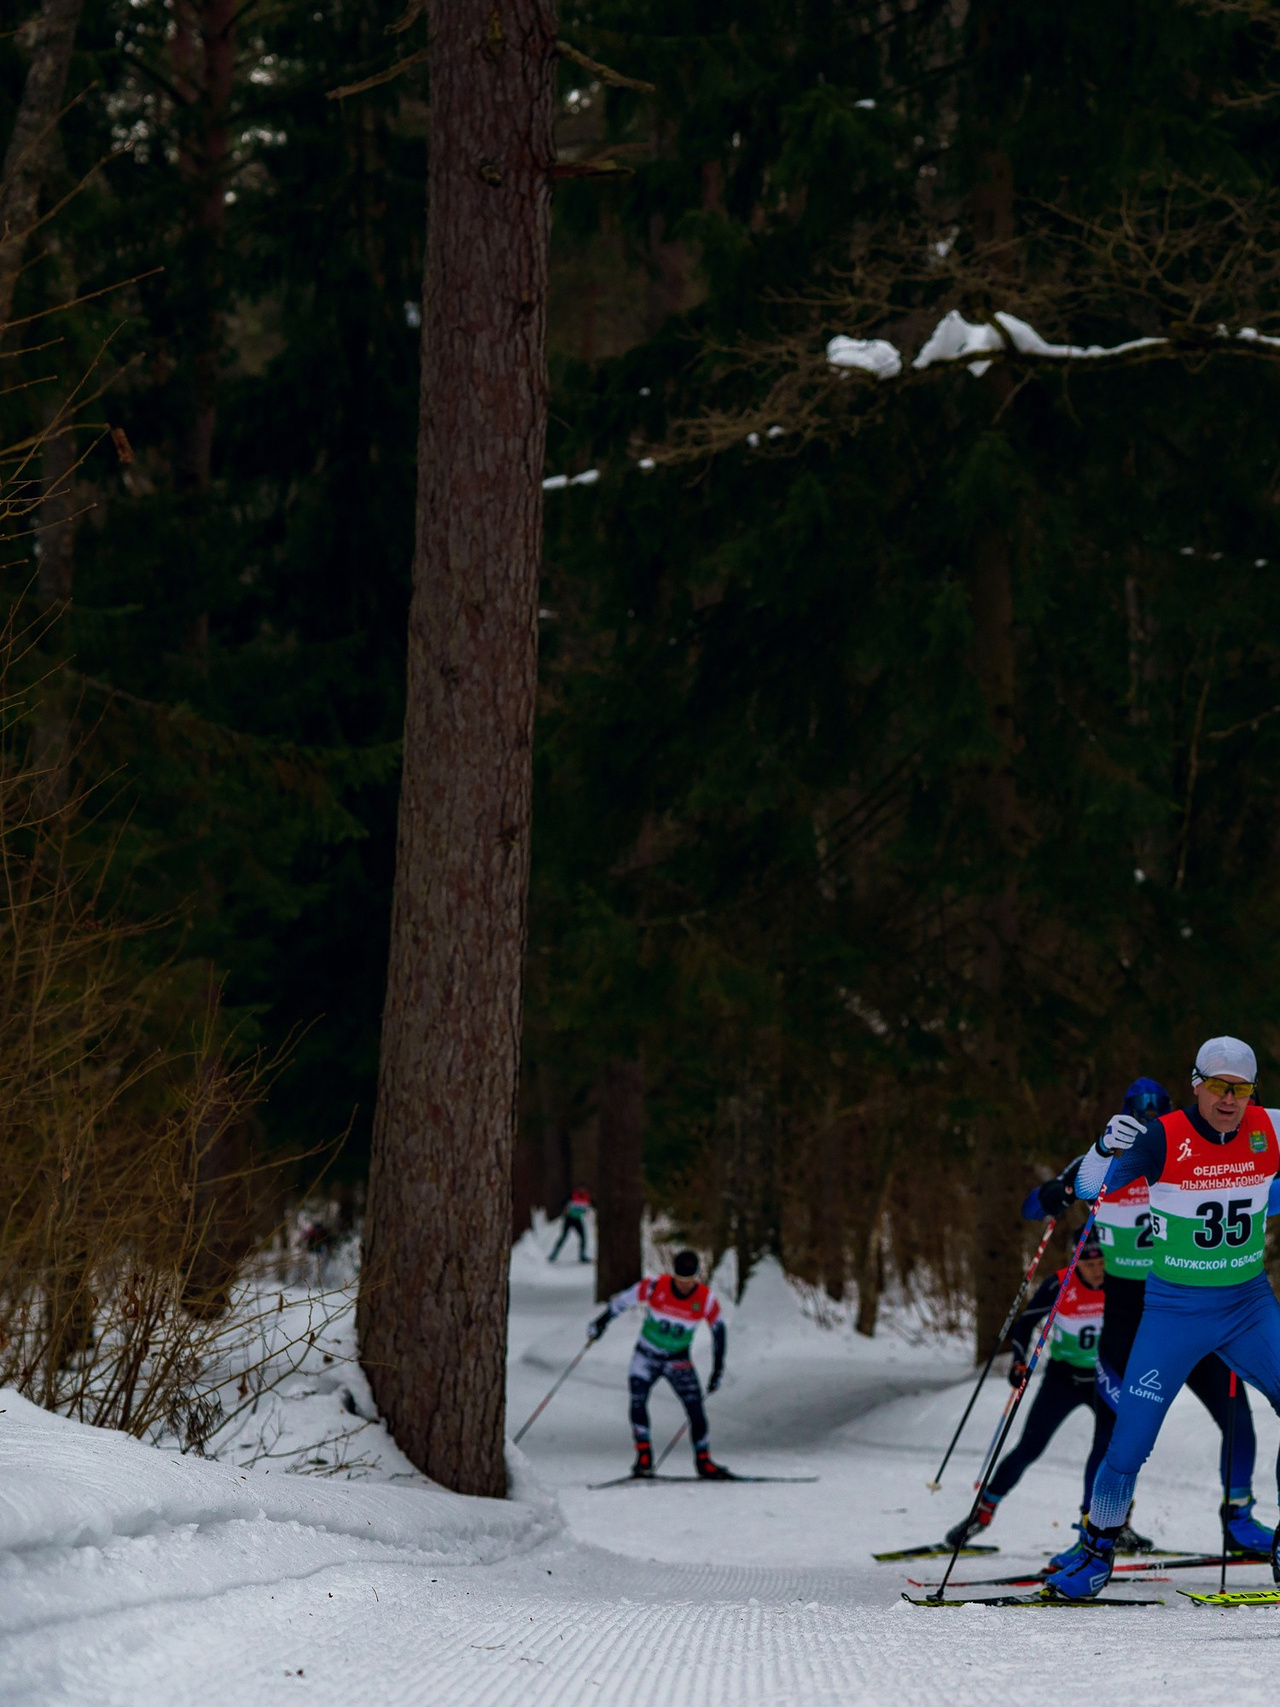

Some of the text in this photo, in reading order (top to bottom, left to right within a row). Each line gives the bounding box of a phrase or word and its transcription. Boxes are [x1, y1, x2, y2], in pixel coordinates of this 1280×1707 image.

[1193, 1161, 1256, 1177] ФЕДЕРАЦИЯ
[1181, 1173, 1266, 1191] ЛЫЖНЫХ ГОНОК
[1194, 1199, 1253, 1249] 35
[1165, 1254, 1227, 1270] КАЛУЖСКОЙ
